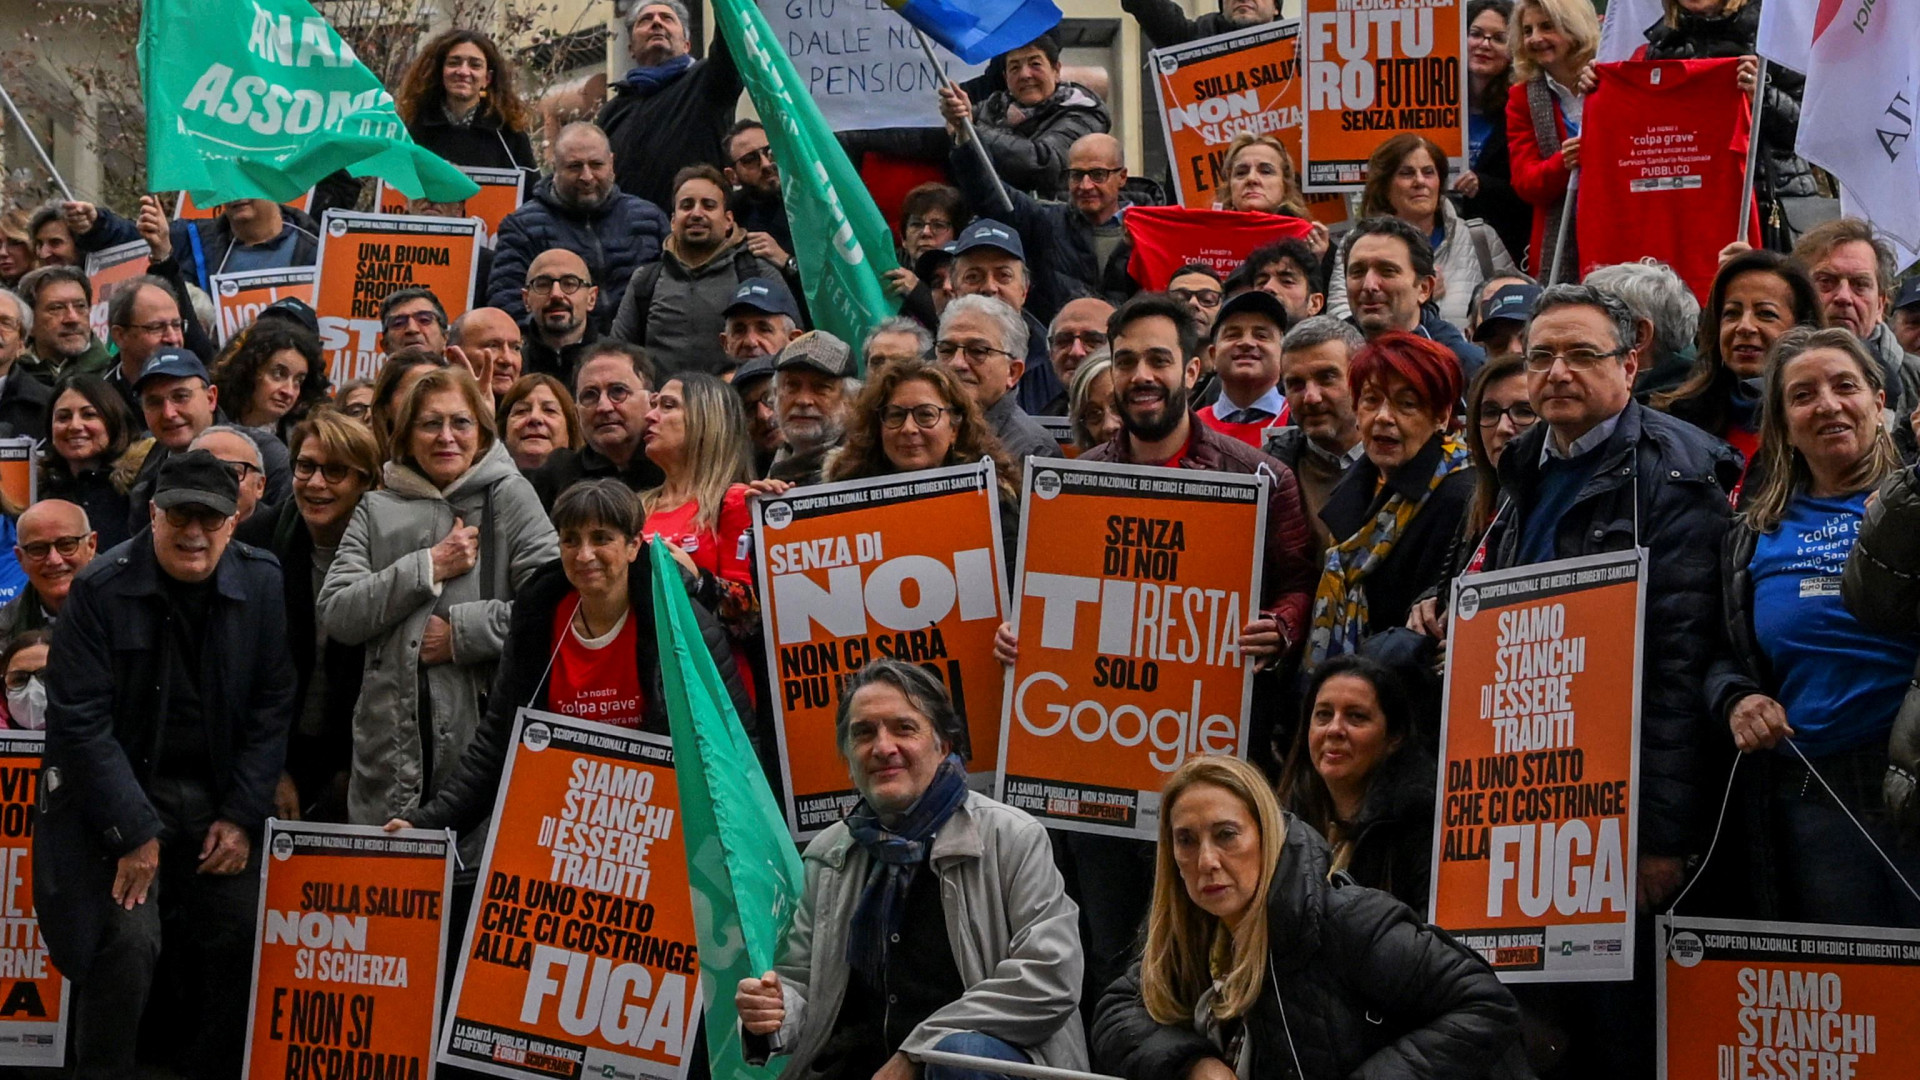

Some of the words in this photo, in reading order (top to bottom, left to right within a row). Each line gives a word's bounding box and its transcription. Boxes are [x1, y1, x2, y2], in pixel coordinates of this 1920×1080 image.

[789, 28, 871, 57] DALLE
[1309, 8, 1434, 61] FUTU
[1193, 71, 1249, 101] SULLA
[1376, 56, 1459, 108] FUTURO
[1168, 89, 1260, 132] NON
[1201, 124, 1221, 146] SI
[1222, 105, 1303, 143] SCHERZA
[1342, 110, 1395, 131] SENZA
[1399, 108, 1459, 131] MEDICI
[1191, 154, 1209, 192] E
[1641, 165, 1690, 176] PUBBLICO
[358, 243, 391, 262] UNA
[394, 244, 450, 266] BUONA
[792, 497, 829, 511] SCIOPERO
[829, 492, 868, 507] NAZIONALE
[870, 490, 883, 501] DEI
[883, 486, 909, 499] MEDICI
[909, 486, 914, 495] E
[914, 481, 950, 495] DIRIGENTI
[1063, 473, 1098, 486] SCIOPERO
[1099, 475, 1137, 490] NAZIONALE
[1139, 479, 1151, 490] DEI
[1152, 480, 1178, 494] MEDICI
[1178, 482, 1183, 493] E
[1184, 482, 1221, 497] DIRIGENTI
[1221, 486, 1255, 500] SANITARI
[770, 535, 853, 575] SENZA
[856, 531, 883, 563] DI
[1105, 515, 1185, 551] SENZA
[1805, 538, 1850, 553] credere
[1103, 545, 1128, 577] DI
[1133, 548, 1178, 581] NOI
[773, 547, 998, 645] NOI
[1024, 571, 1136, 657] TI
[1135, 581, 1241, 668] RESTA
[1497, 603, 1565, 647] SIAMO
[781, 641, 839, 679] NON
[843, 637, 871, 670] CI
[875, 621, 948, 663] SARÀ
[1495, 636, 1586, 683] STANCHI
[590, 688, 617, 697] nostra
[1093, 656, 1159, 693] SOLO
[558, 700, 597, 717] "colpa
[600, 696, 640, 715] grave"
[1480, 684, 1492, 720] DI
[1493, 674, 1573, 718] ESSERE
[1014, 671, 1236, 773] Google
[1492, 711, 1575, 754] TRADITI
[552, 727, 588, 744] SCIOPERO
[588, 734, 628, 752] NAZIONALE
[628, 742, 641, 755] DEI
[641, 745, 667, 759] MEDICI
[666, 751, 672, 761] E
[568, 757, 655, 803] SIAMO
[1008, 781, 1018, 793] LA
[1018, 782, 1043, 796] SANITÀ
[1044, 785, 1079, 800] PUBBLICA
[1081, 790, 1097, 802] NON
[1098, 792, 1106, 803] SI
[1448, 758, 1472, 793] DA
[1477, 754, 1518, 791] UNO
[1521, 748, 1584, 787] STATO
[561, 788, 675, 840] STANCHI
[799, 801, 809, 812] LA
[1446, 792, 1484, 827] CHE
[1488, 789, 1508, 824] CI
[1512, 780, 1627, 823] COSTRINGE
[537, 815, 557, 848] DI
[554, 819, 654, 869] ESSERE
[550, 851, 651, 900] TRADITI
[1442, 827, 1491, 863] ALLA
[1486, 817, 1627, 918] FUGA
[300, 881, 361, 915] SULLA
[364, 885, 442, 921] SALUTE
[488, 871, 521, 904] DA
[525, 879, 577, 916] UNO
[579, 891, 655, 933] STATO
[265, 909, 368, 952] NON
[481, 902, 533, 938] CHE
[533, 911, 559, 944] CI
[562, 918, 699, 976] COSTRINGE
[1704, 934, 1748, 950] SCIOPERO
[1749, 936, 1798, 953] NAZIONALE
[1801, 940, 1816, 954] DEI
[1817, 940, 1848, 956] MEDICI
[1849, 942, 1855, 957] E
[1856, 943, 1901, 959] DIRIGENTI
[294, 948, 315, 980] SI
[317, 950, 407, 988] SCHERZA
[473, 932, 536, 972] ALLA
[519, 943, 687, 1057] FUGA
[1737, 967, 1842, 1013] SIAMO
[270, 987, 288, 1041] E
[289, 989, 345, 1047] NON
[347, 993, 375, 1050] SI
[455, 1024, 465, 1037] LA
[465, 1026, 492, 1042] SANITÀ
[491, 1032, 528, 1050] PUBBLICA
[528, 1040, 546, 1054] NON
[545, 1043, 554, 1056] SI
[1737, 1007, 1876, 1054] STANCHI
[452, 1036, 461, 1049] SI
[1718, 1045, 1734, 1080] DI
[1738, 1046, 1859, 1080] ESSERE
